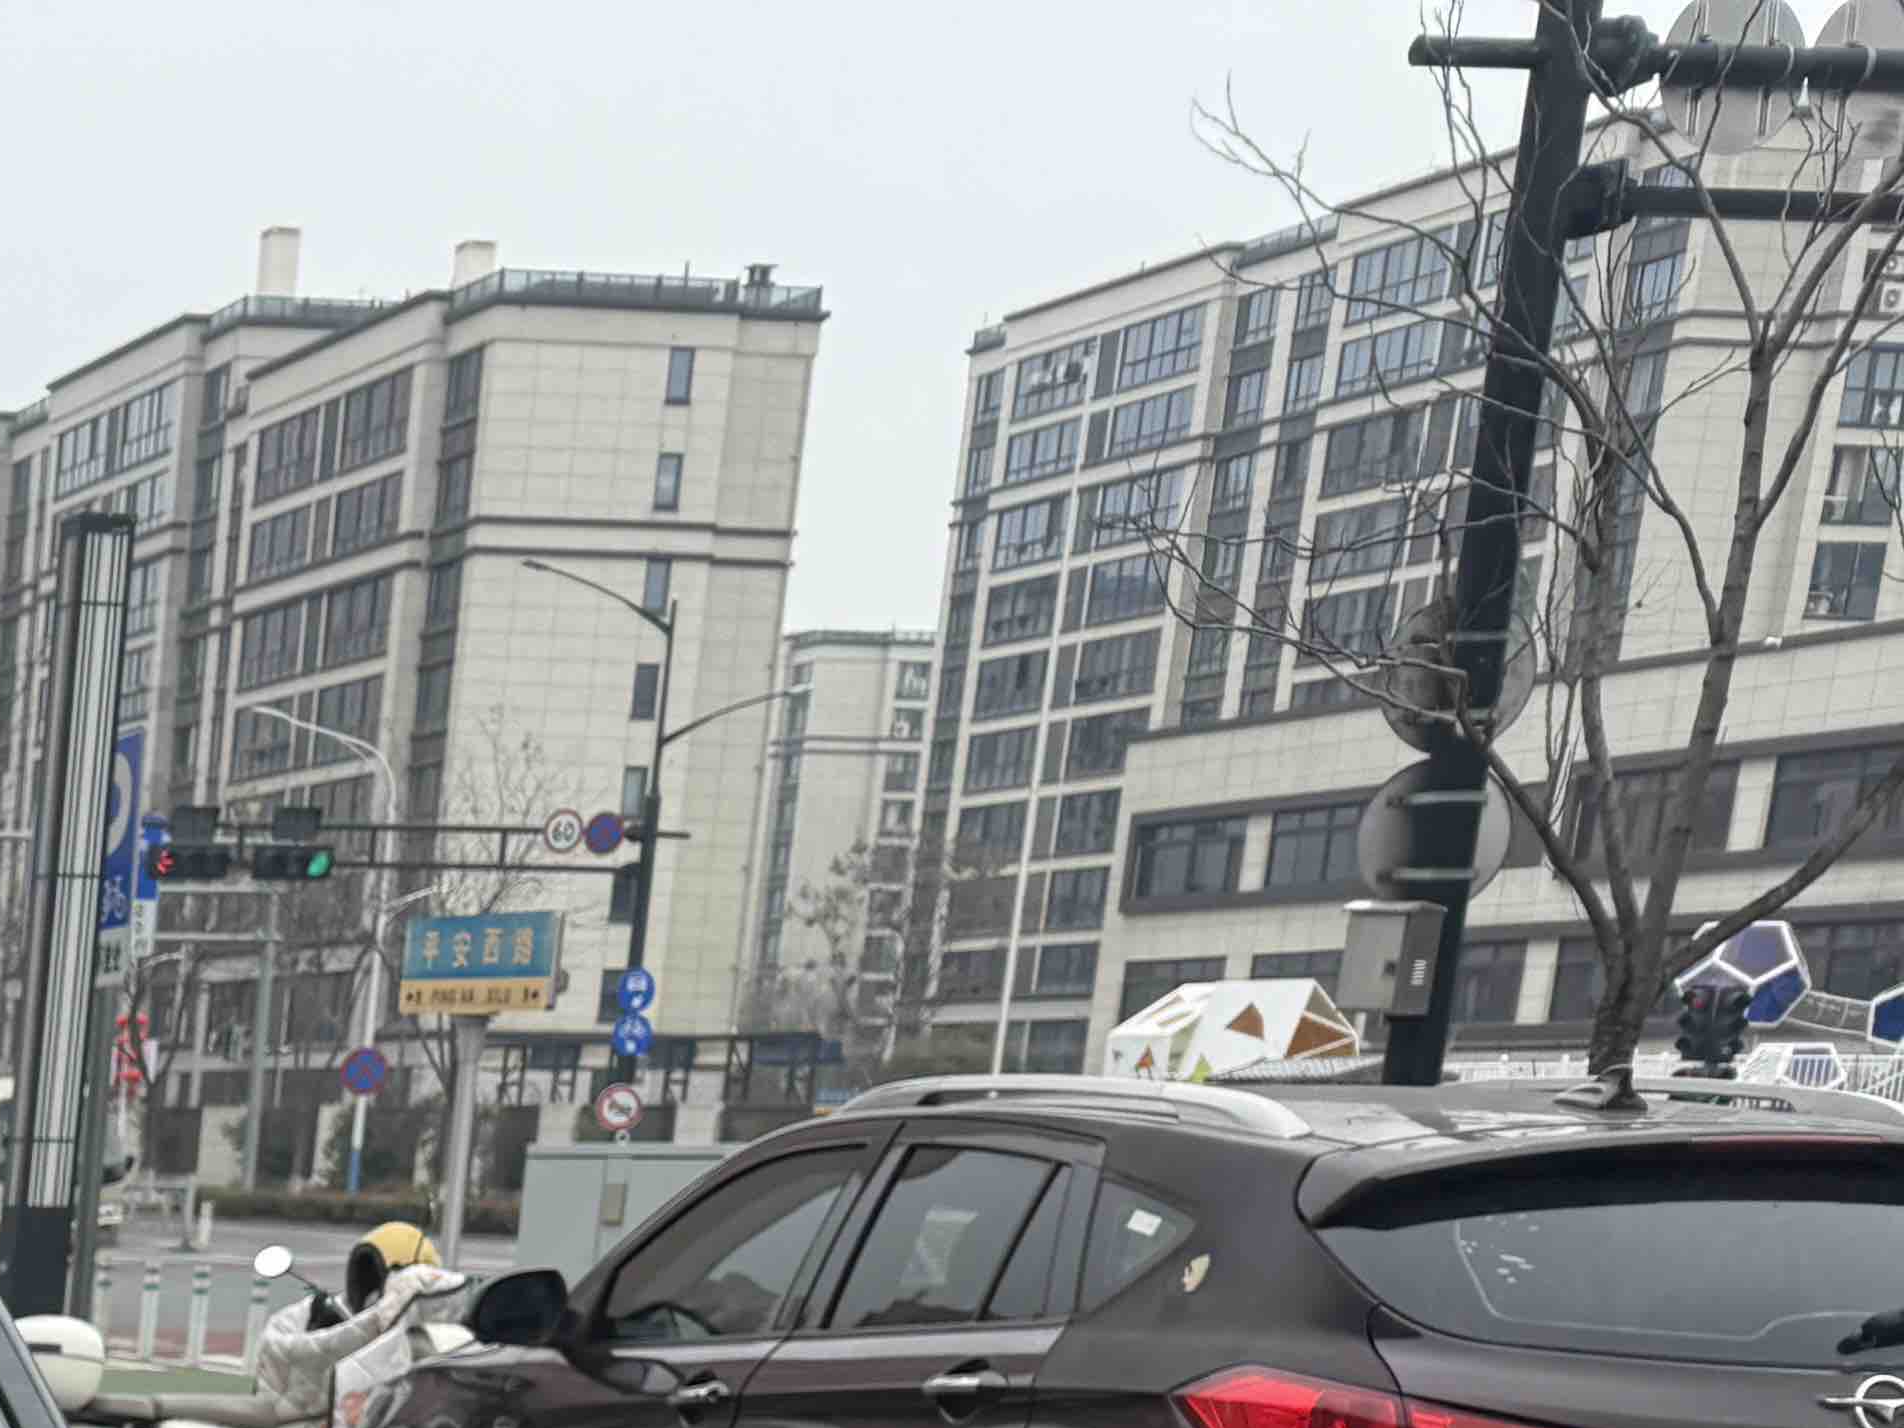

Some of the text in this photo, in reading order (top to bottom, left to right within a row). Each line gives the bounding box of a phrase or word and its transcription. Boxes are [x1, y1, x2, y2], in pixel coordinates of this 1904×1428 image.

[552, 820, 575, 842] 60
[423, 926, 535, 969] 平安西路
